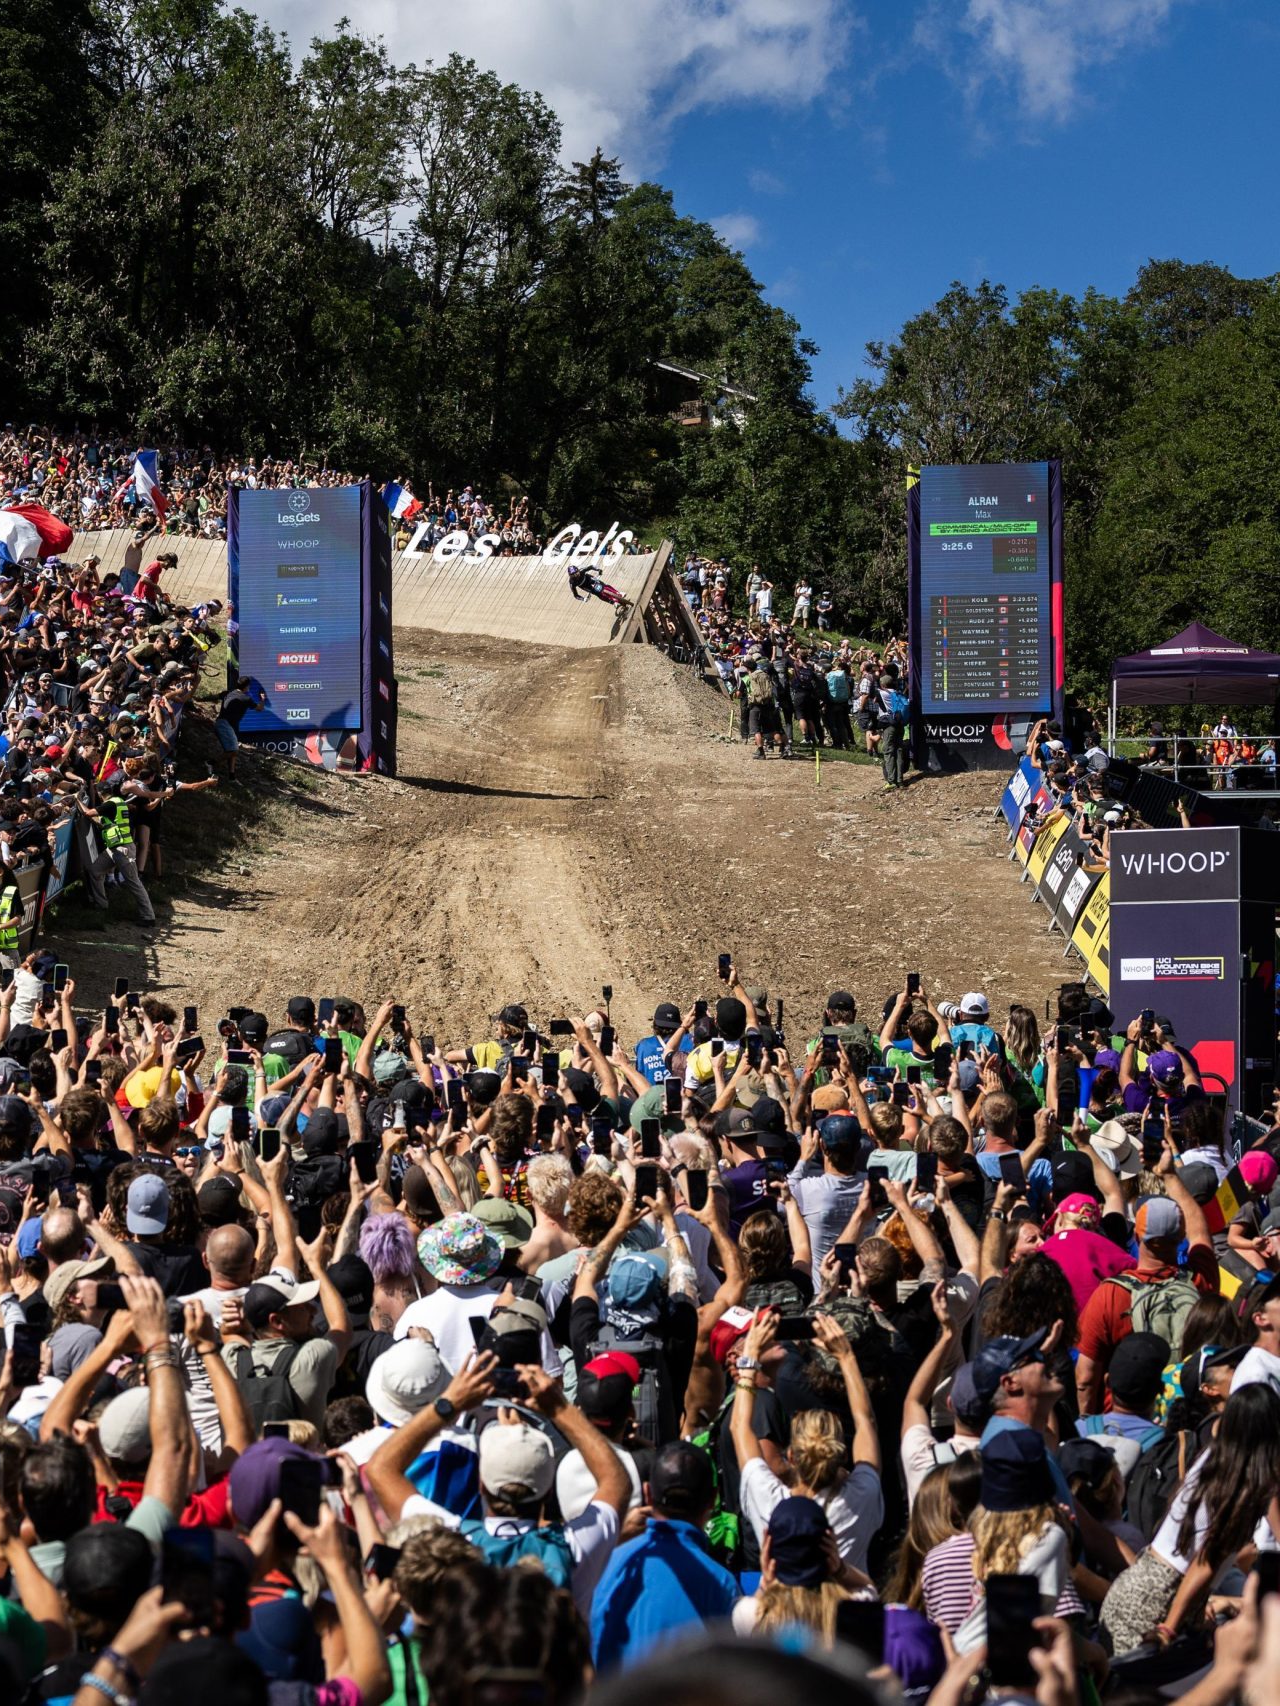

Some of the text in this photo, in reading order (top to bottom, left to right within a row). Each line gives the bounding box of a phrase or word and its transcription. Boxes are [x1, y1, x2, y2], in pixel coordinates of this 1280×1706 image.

[968, 496, 998, 506] ALRAN
[277, 512, 320, 523] Les Gets
[975, 510, 992, 519] Max
[277, 540, 319, 549] WHOOP
[402, 521, 500, 565] Les
[942, 542, 973, 551] 3:25.6
[279, 626, 317, 634] SHIMANO
[279, 654, 317, 664] MOTUL
[290, 710, 308, 719] UCI
[923, 723, 985, 737] WHOOP
[1056, 843, 1073, 872] GoPro
[1120, 851, 1226, 875] WHOOP
[1123, 965, 1152, 973] WHOOP
[648, 1061, 665, 1069] HOL
